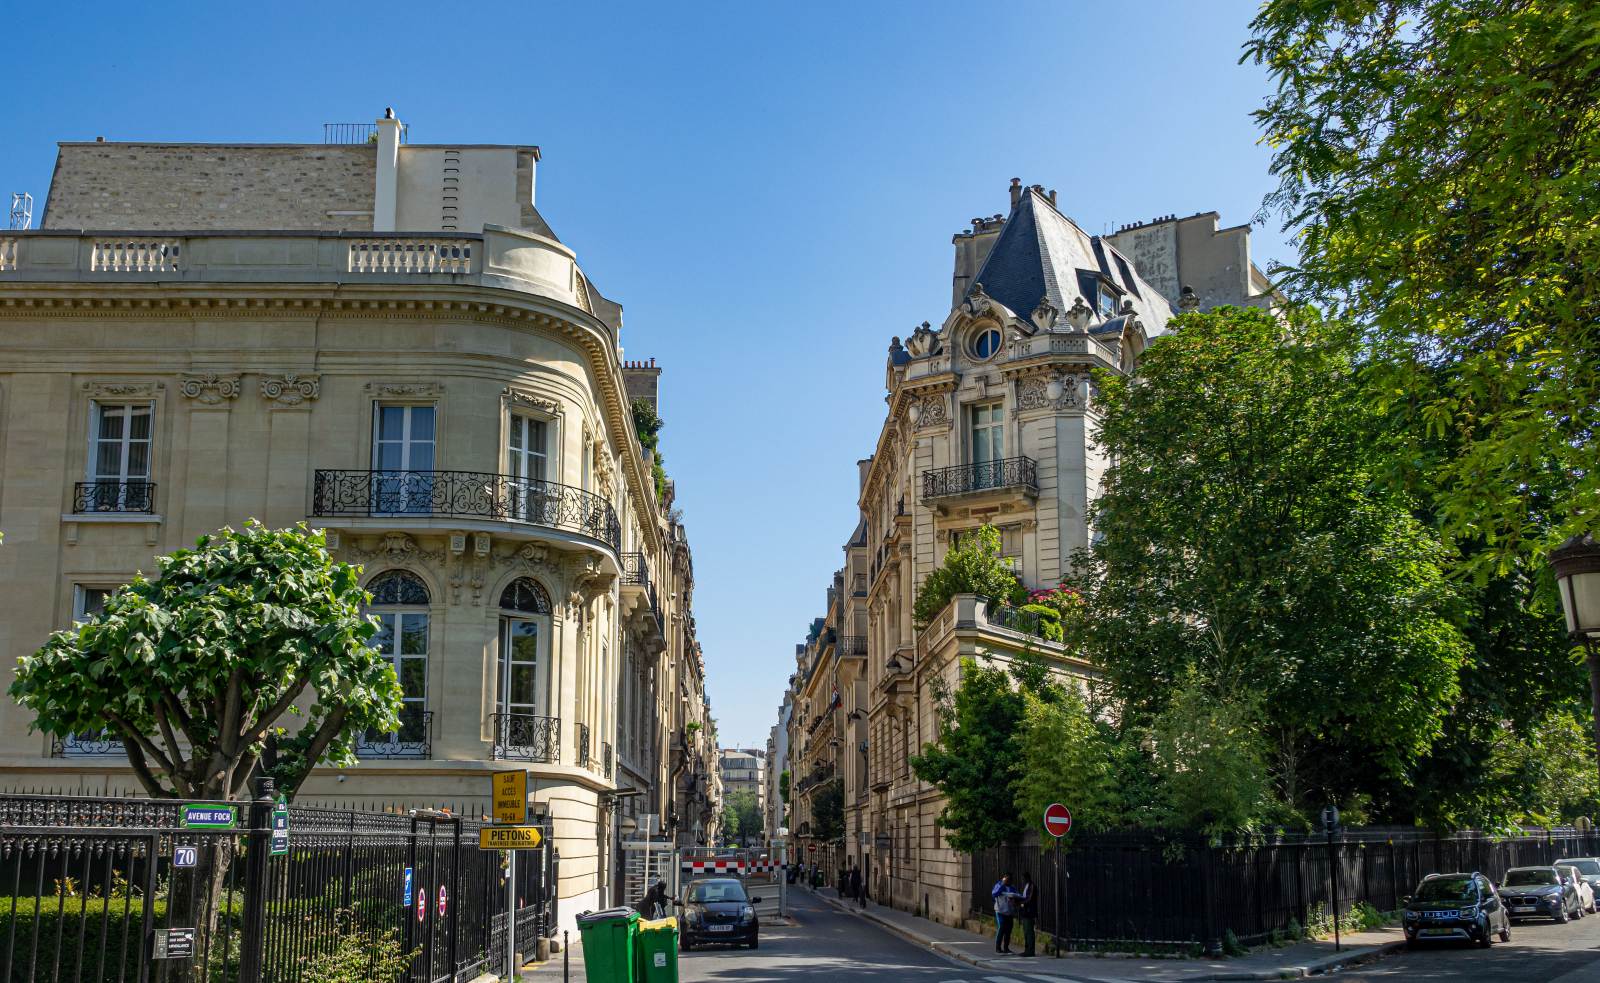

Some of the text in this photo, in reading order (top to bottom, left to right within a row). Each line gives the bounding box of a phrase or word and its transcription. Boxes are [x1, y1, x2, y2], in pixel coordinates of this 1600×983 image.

[187, 812, 231, 821] AVENUE FOCH
[491, 830, 531, 841] PIETONS
[177, 849, 194, 865] 70
